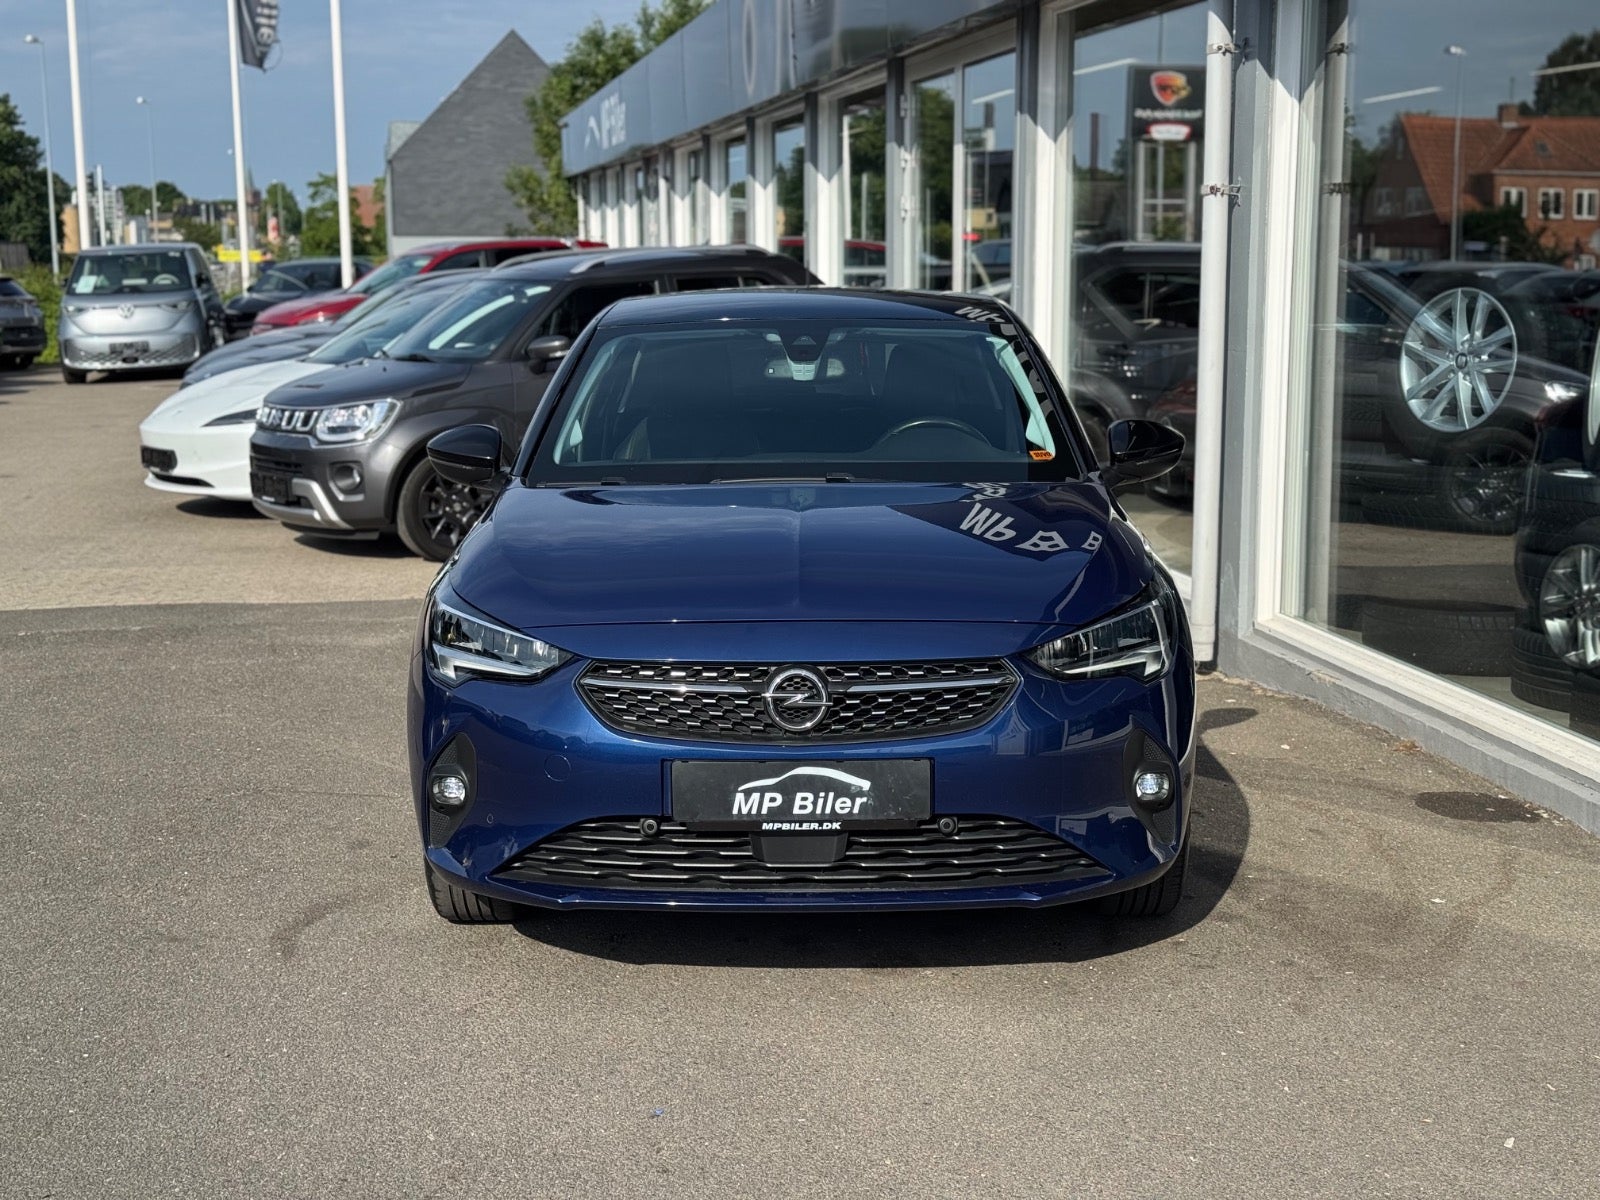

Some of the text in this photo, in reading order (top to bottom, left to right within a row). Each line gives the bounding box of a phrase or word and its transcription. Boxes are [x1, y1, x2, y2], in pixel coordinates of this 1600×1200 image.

[732, 791, 868, 815] MP Biler
[762, 821, 842, 831] MPBILER.DK
